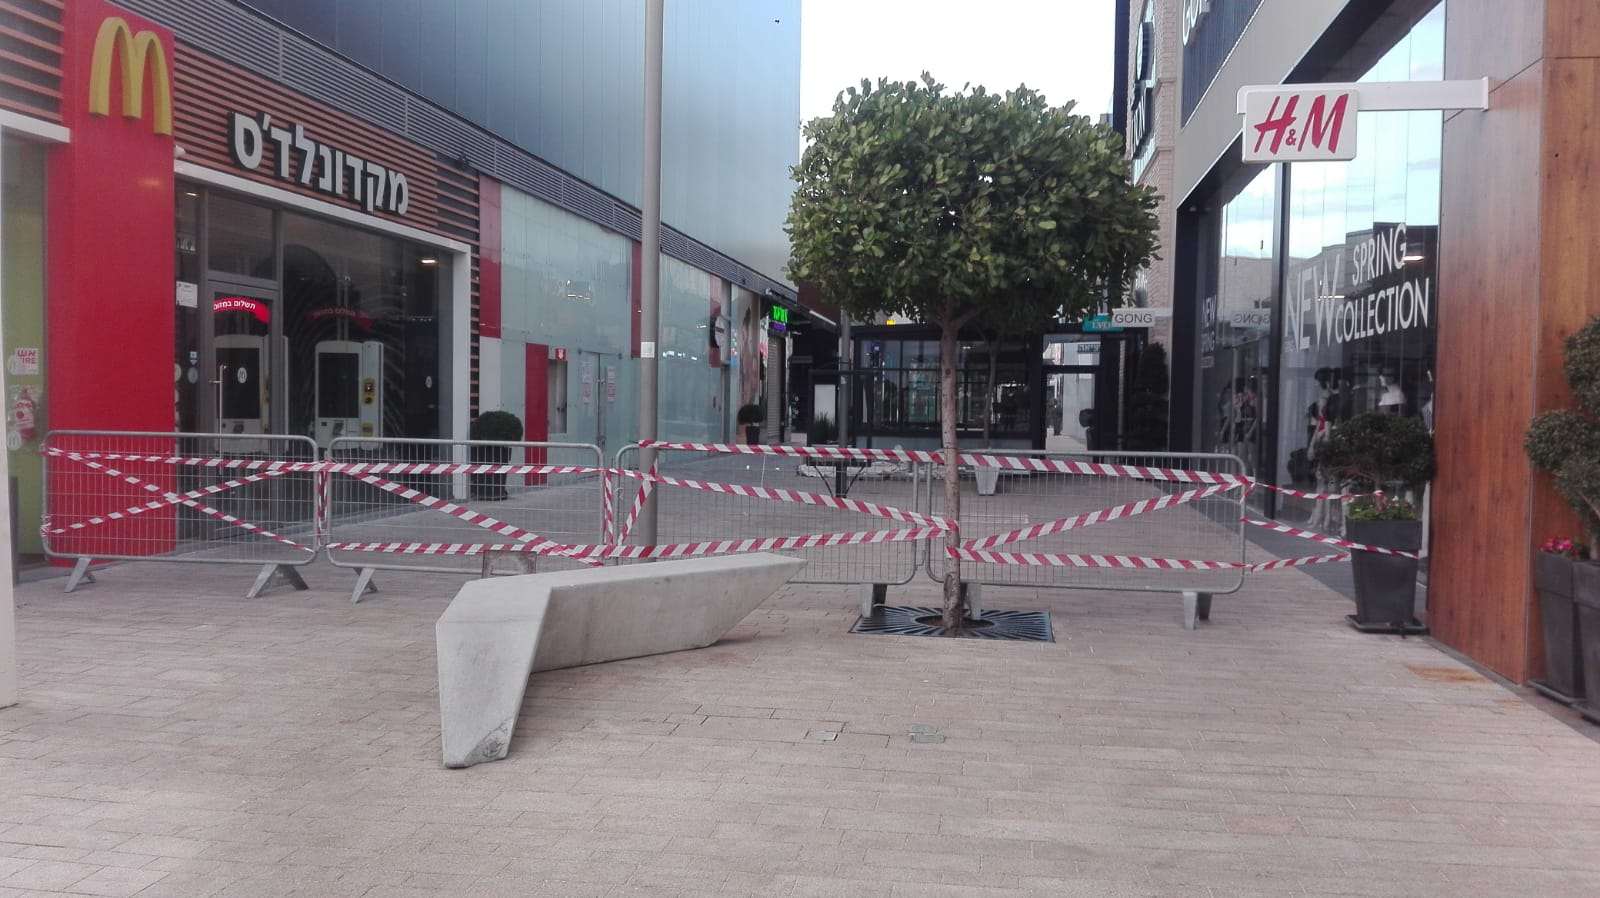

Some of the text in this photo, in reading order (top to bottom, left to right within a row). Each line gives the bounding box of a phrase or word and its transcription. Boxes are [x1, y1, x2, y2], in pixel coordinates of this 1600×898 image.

[1254, 93, 1349, 155] H&M
[234, 112, 409, 215] מקדונלד'ס
[1352, 223, 1407, 286] SPRING
[1114, 313, 1153, 324] GONG
[1284, 254, 1430, 352] NEW COLLECTION
